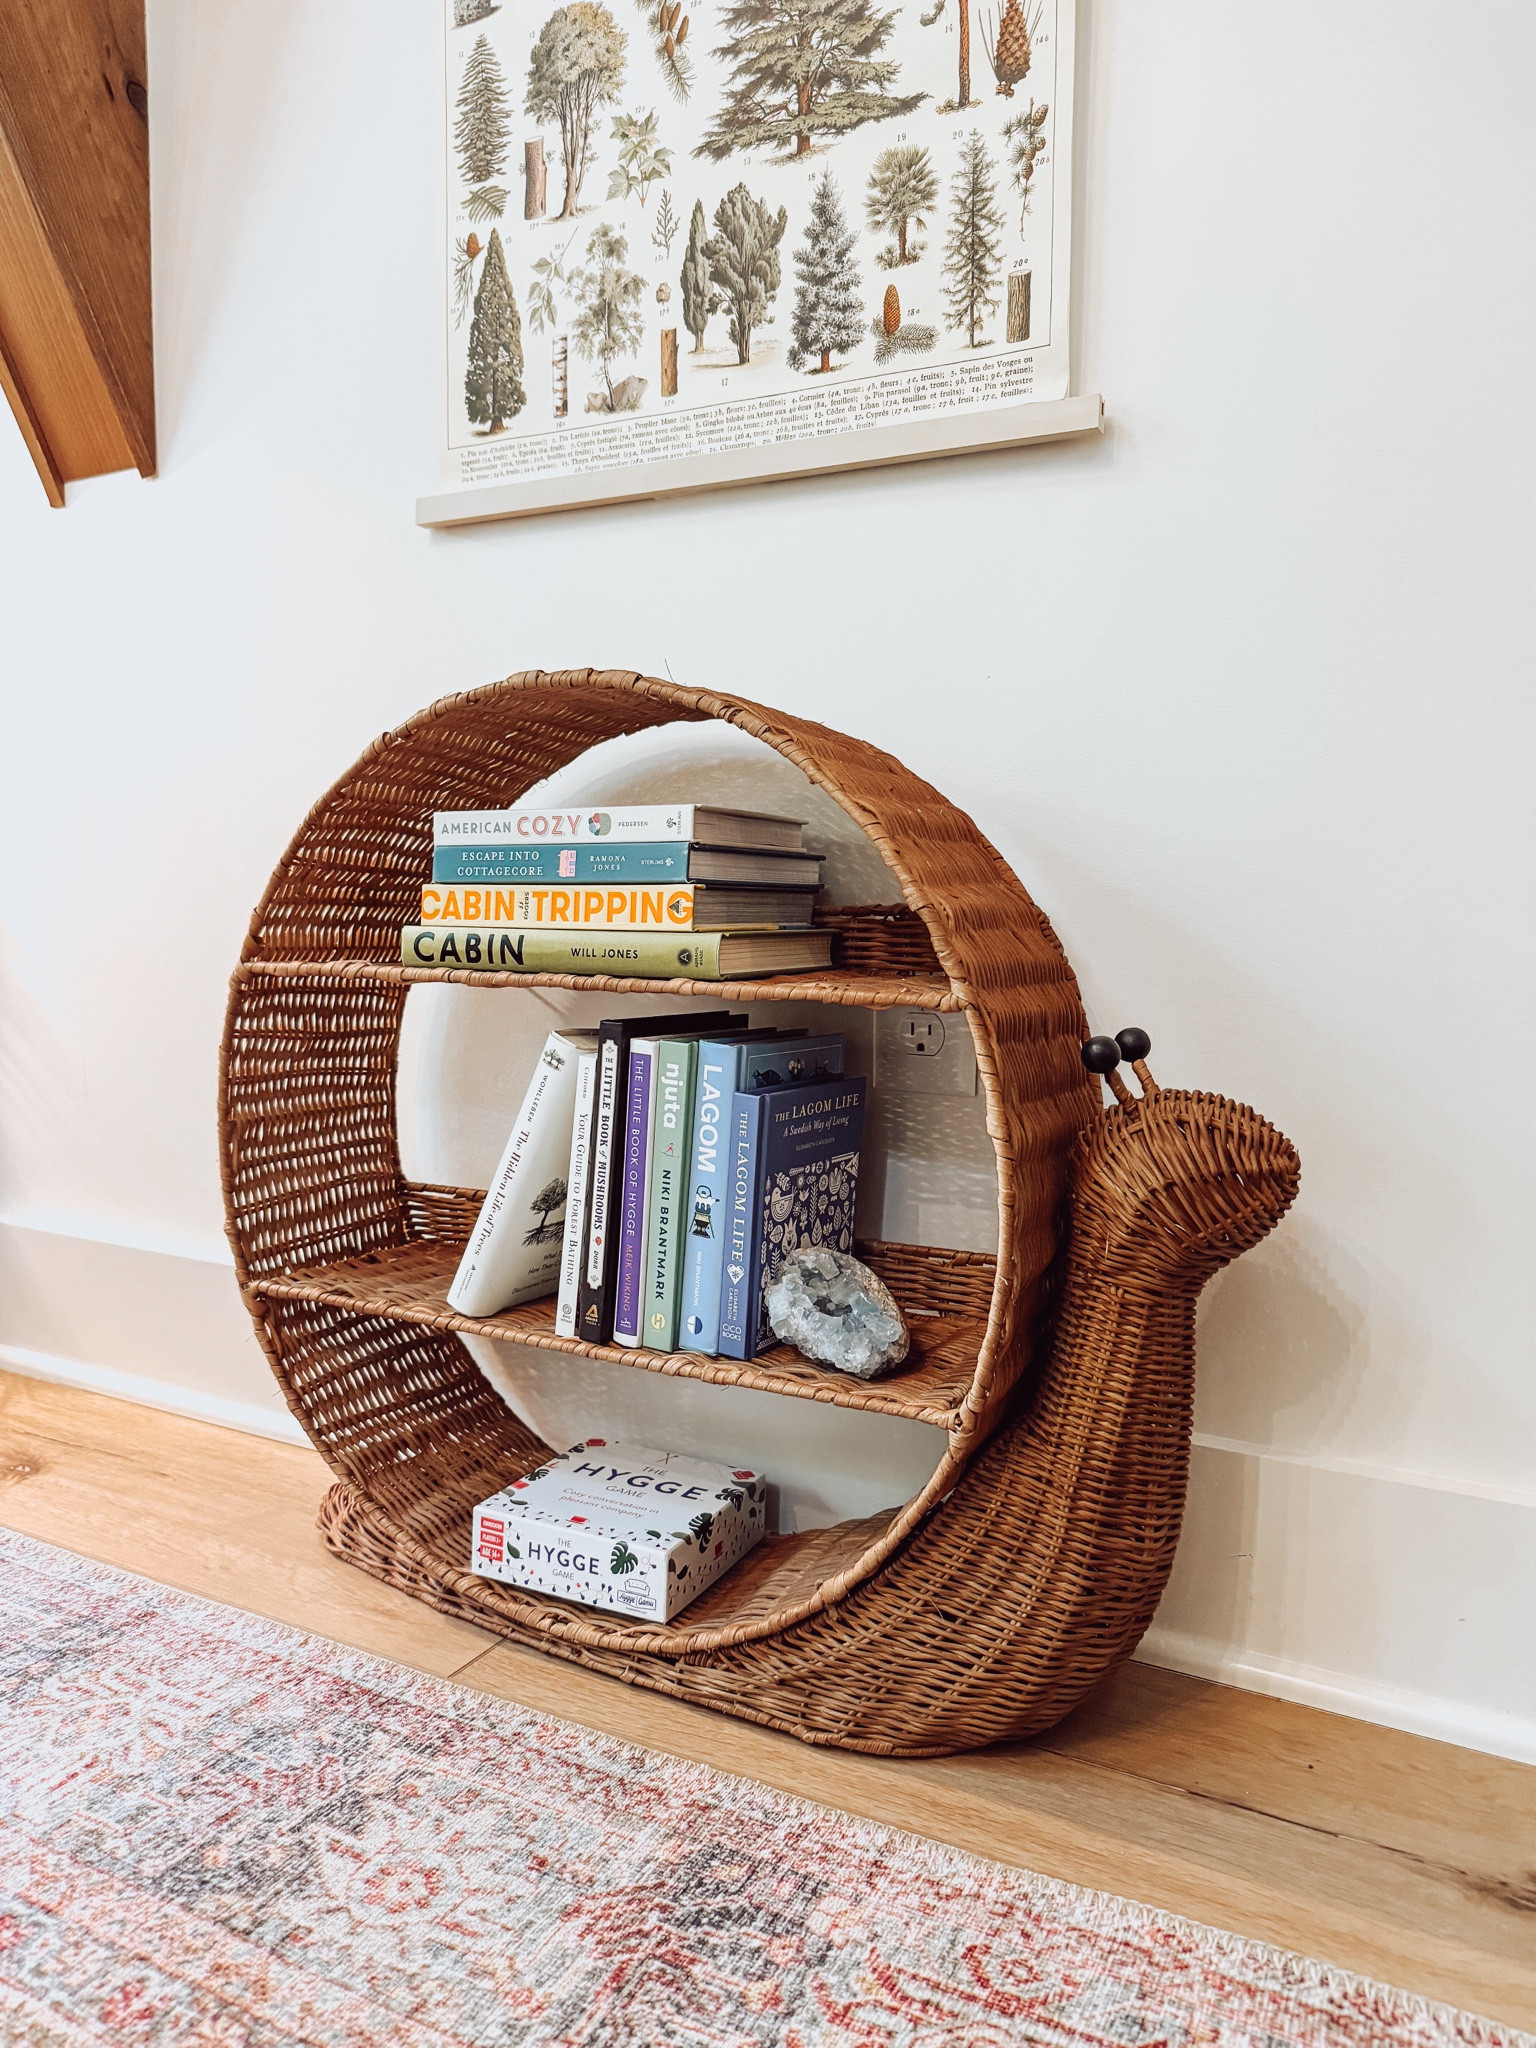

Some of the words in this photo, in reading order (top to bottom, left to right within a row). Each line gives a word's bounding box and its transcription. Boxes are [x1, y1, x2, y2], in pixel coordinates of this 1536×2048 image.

[959, 364, 980, 376] Sapin
[982, 361, 994, 371] des
[996, 357, 1021, 369] Vosges
[1023, 356, 1033, 364] ou
[860, 400, 879, 411] Liban
[984, 381, 996, 390] Pin
[999, 374, 1033, 389] sylvestre
[872, 391, 884, 399] Pin
[886, 386, 910, 398] parasol
[441, 821, 511, 835] AMERICAN
[516, 814, 582, 837] COZY
[457, 866, 543, 877] COTTAGECORE
[462, 851, 505, 862] ESCAPE
[510, 851, 540, 861] INTO
[589, 855, 626, 863] RAMONA
[592, 864, 621, 872] JONES
[421, 890, 515, 921] CABIN
[532, 891, 694, 925] TRIPPING
[413, 931, 525, 966] CABIN
[570, 947, 597, 958] WILL
[601, 948, 639, 959] JONES
[634, 1060, 644, 1082] THE
[526, 1075, 549, 1123] WOHLLEBEN
[602, 1066, 613, 1109] LITTLE
[661, 1063, 683, 1129] njuta
[632, 1087, 642, 1126] LITTLE
[697, 1064, 723, 1173] LAGOM
[774, 1111, 790, 1123] THE
[792, 1099, 832, 1119] LAGOM
[834, 1093, 859, 1110] LIFE
[599, 1114, 610, 1147] BOOK
[739, 1111, 748, 1137] THE
[515, 1130, 531, 1151] The
[630, 1129, 640, 1165] BOOK
[499, 1152, 521, 1191] Hidden
[575, 1144, 586, 1177] GUIDE
[629, 1170, 638, 1187] OF
[661, 1169, 671, 1200] NIKI
[734, 1140, 749, 1213] LAGOM
[492, 1192, 506, 1217] Life
[593, 1160, 607, 1230] MUSHROOMS
[571, 1199, 581, 1236] FOREST
[626, 1192, 637, 1237] HYGGE
[474, 1227, 494, 1256] Trees
[655, 1206, 669, 1300] BRANTMARK
[731, 1217, 745, 1262] LIFE
[566, 1239, 578, 1286] BATHING
[625, 1244, 633, 1268] MEIK
[623, 1272, 632, 1311] WIKING
[572, 1462, 709, 1500] HYGGE
[642, 1465, 669, 1476] THE
[558, 1495, 599, 1508] pleasant
[600, 1504, 646, 1519] company
[563, 1487, 589, 1499] Cozy
[588, 1493, 648, 1512] conversation
[649, 1506, 660, 1515] in
[605, 1485, 648, 1499] GAME
[528, 1541, 600, 1576] HYGGE
[557, 1537, 572, 1549] THE
[552, 1567, 575, 1581] GAME
